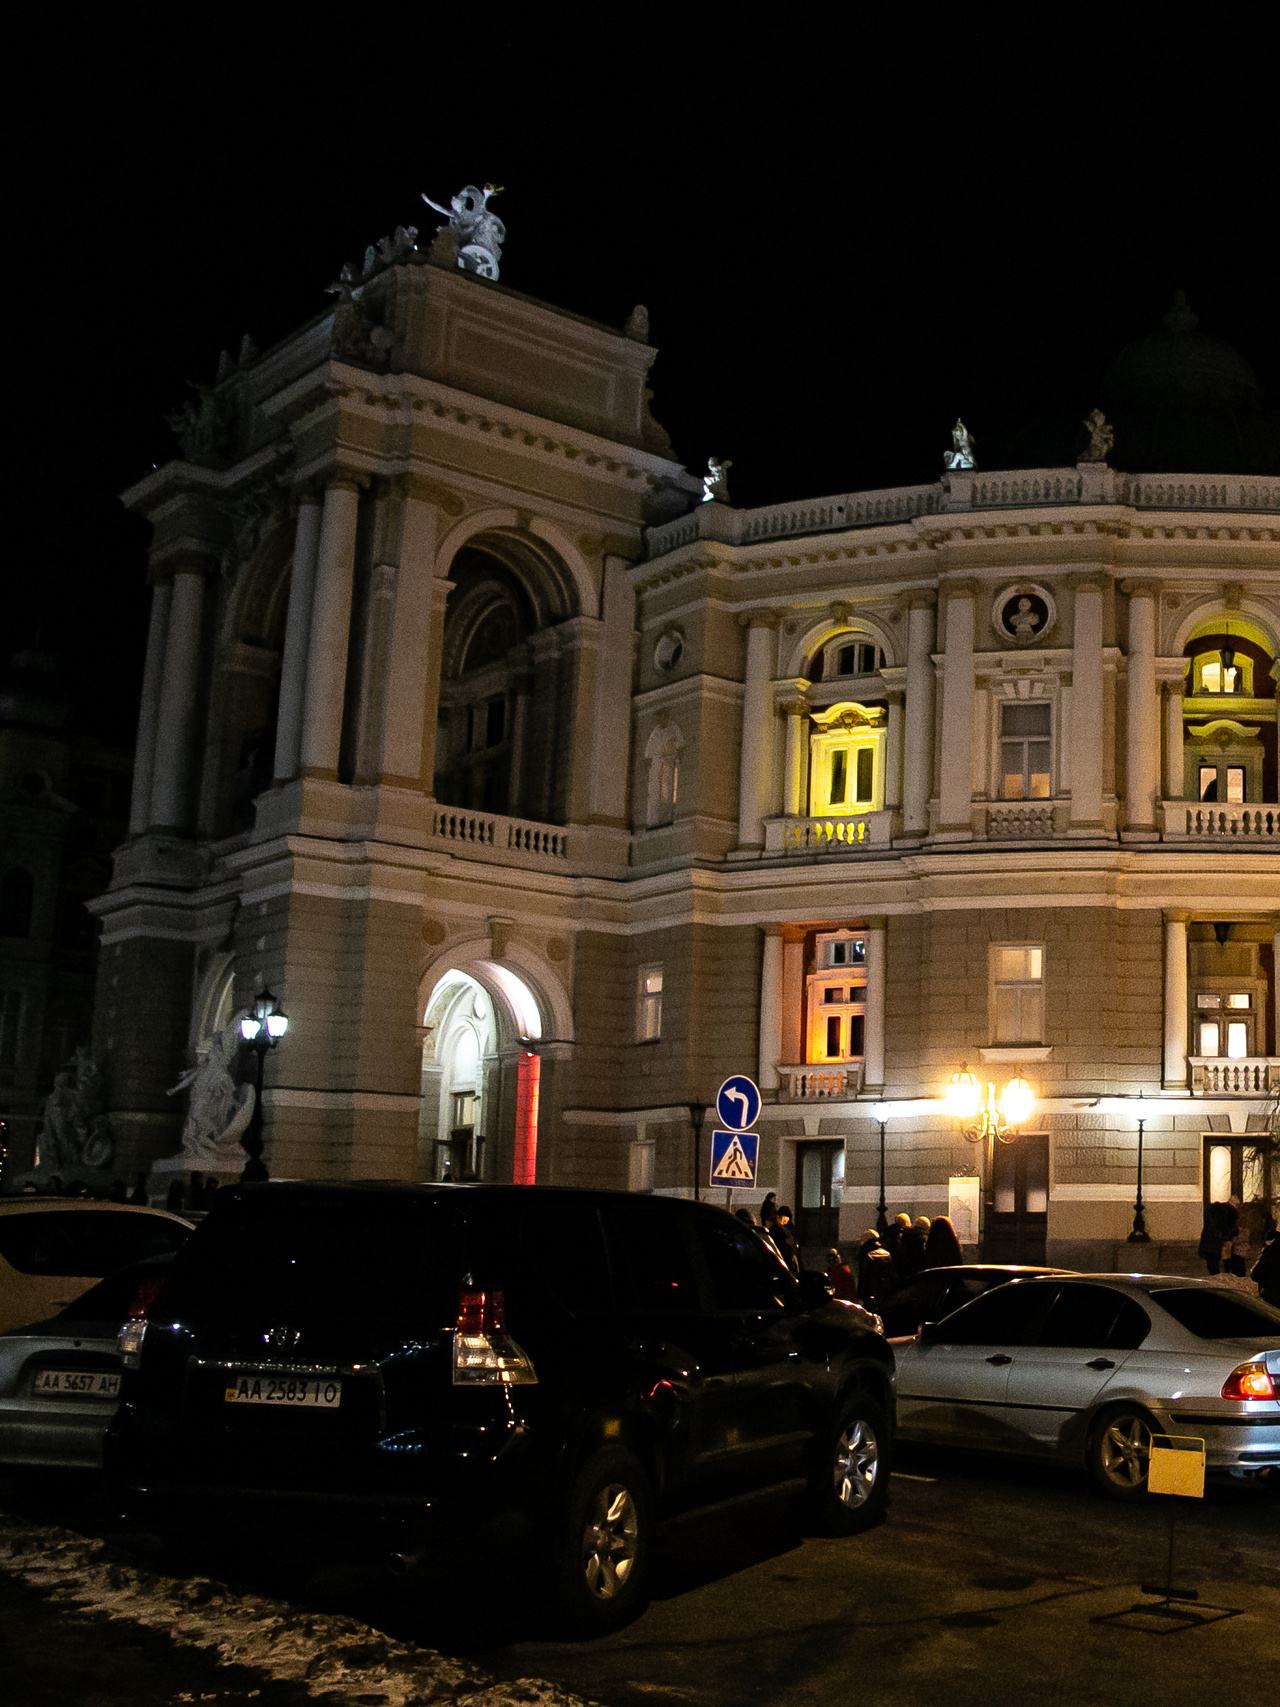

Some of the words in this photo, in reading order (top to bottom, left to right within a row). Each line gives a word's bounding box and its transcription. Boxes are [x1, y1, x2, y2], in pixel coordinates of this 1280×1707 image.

[42, 1374, 60, 1389] AA
[99, 1376, 119, 1392] AH
[237, 1379, 262, 1399] AA
[266, 1381, 308, 1401] 2583
